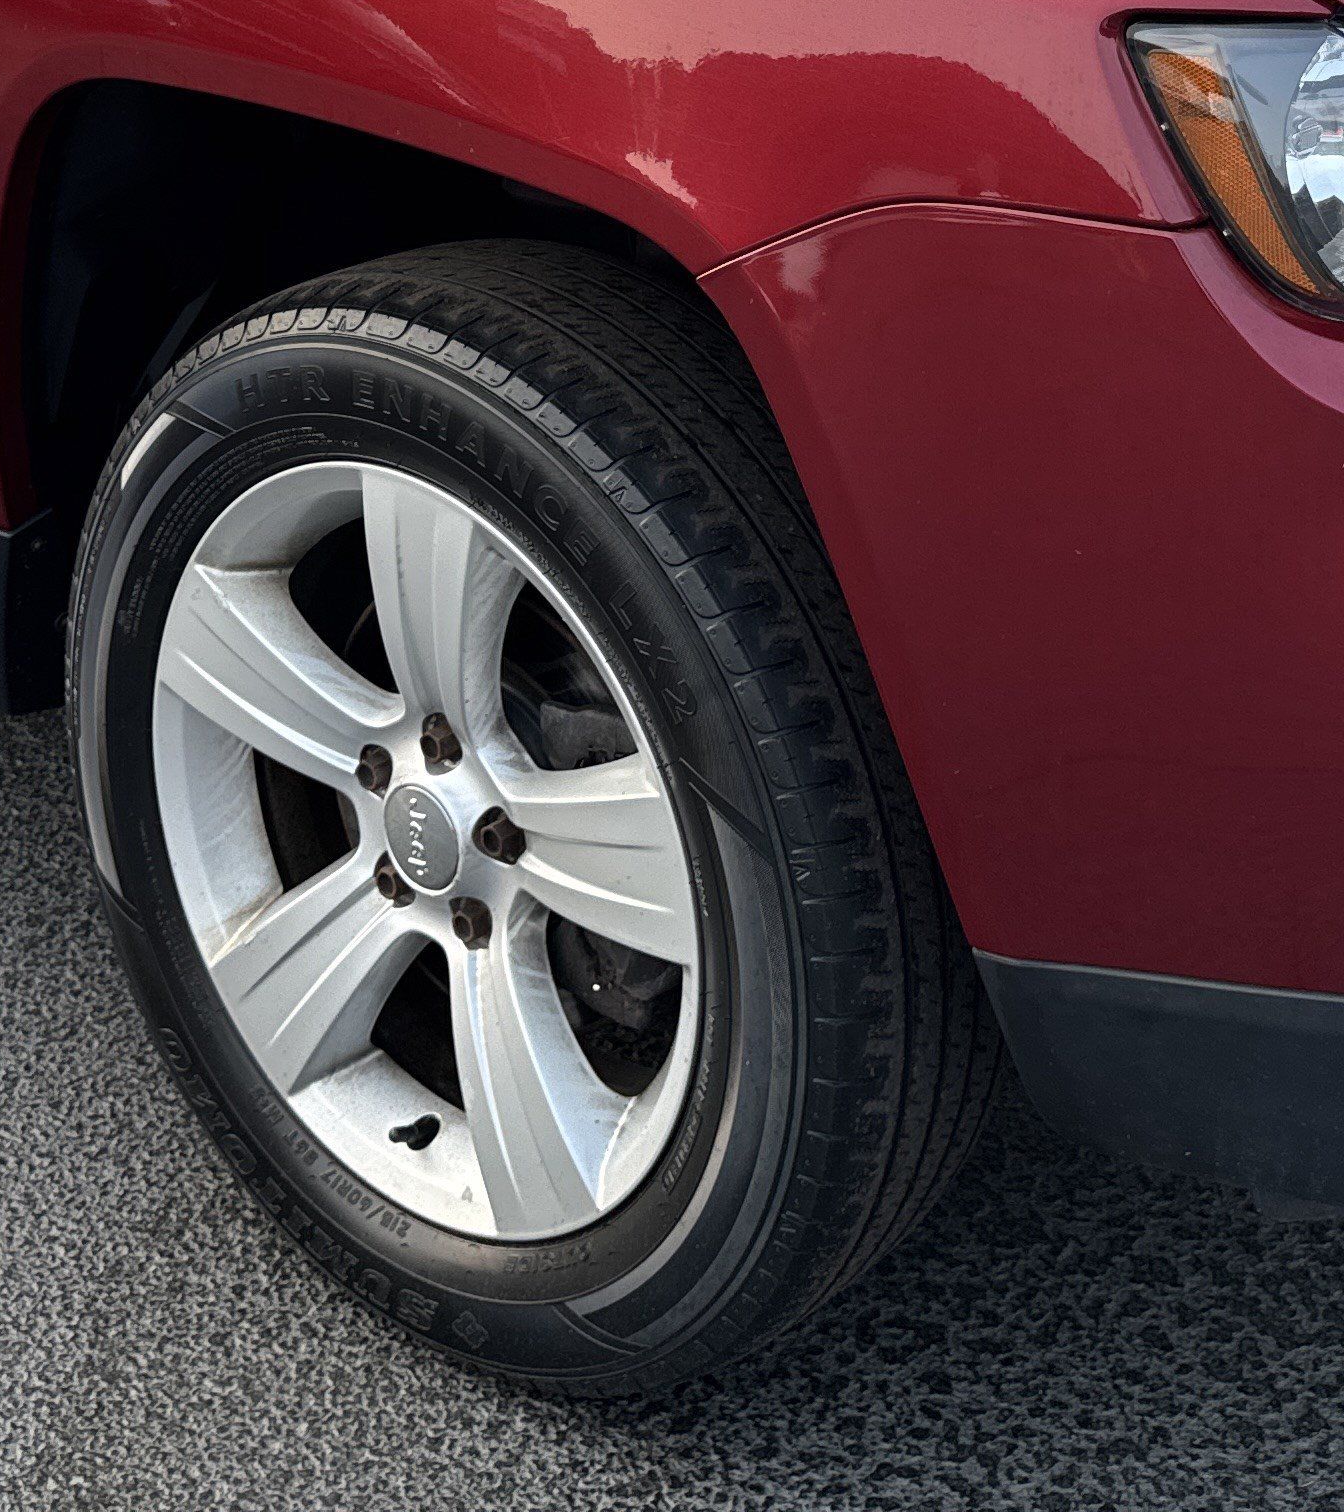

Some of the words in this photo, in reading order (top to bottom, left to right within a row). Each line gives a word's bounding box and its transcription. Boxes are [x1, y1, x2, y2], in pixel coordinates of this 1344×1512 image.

[236, 364, 332, 412] HTR
[352, 369, 600, 567] ENHANCE
[610, 580, 698, 726] LX2
[157, 1028, 439, 1331] SUMITOMO
